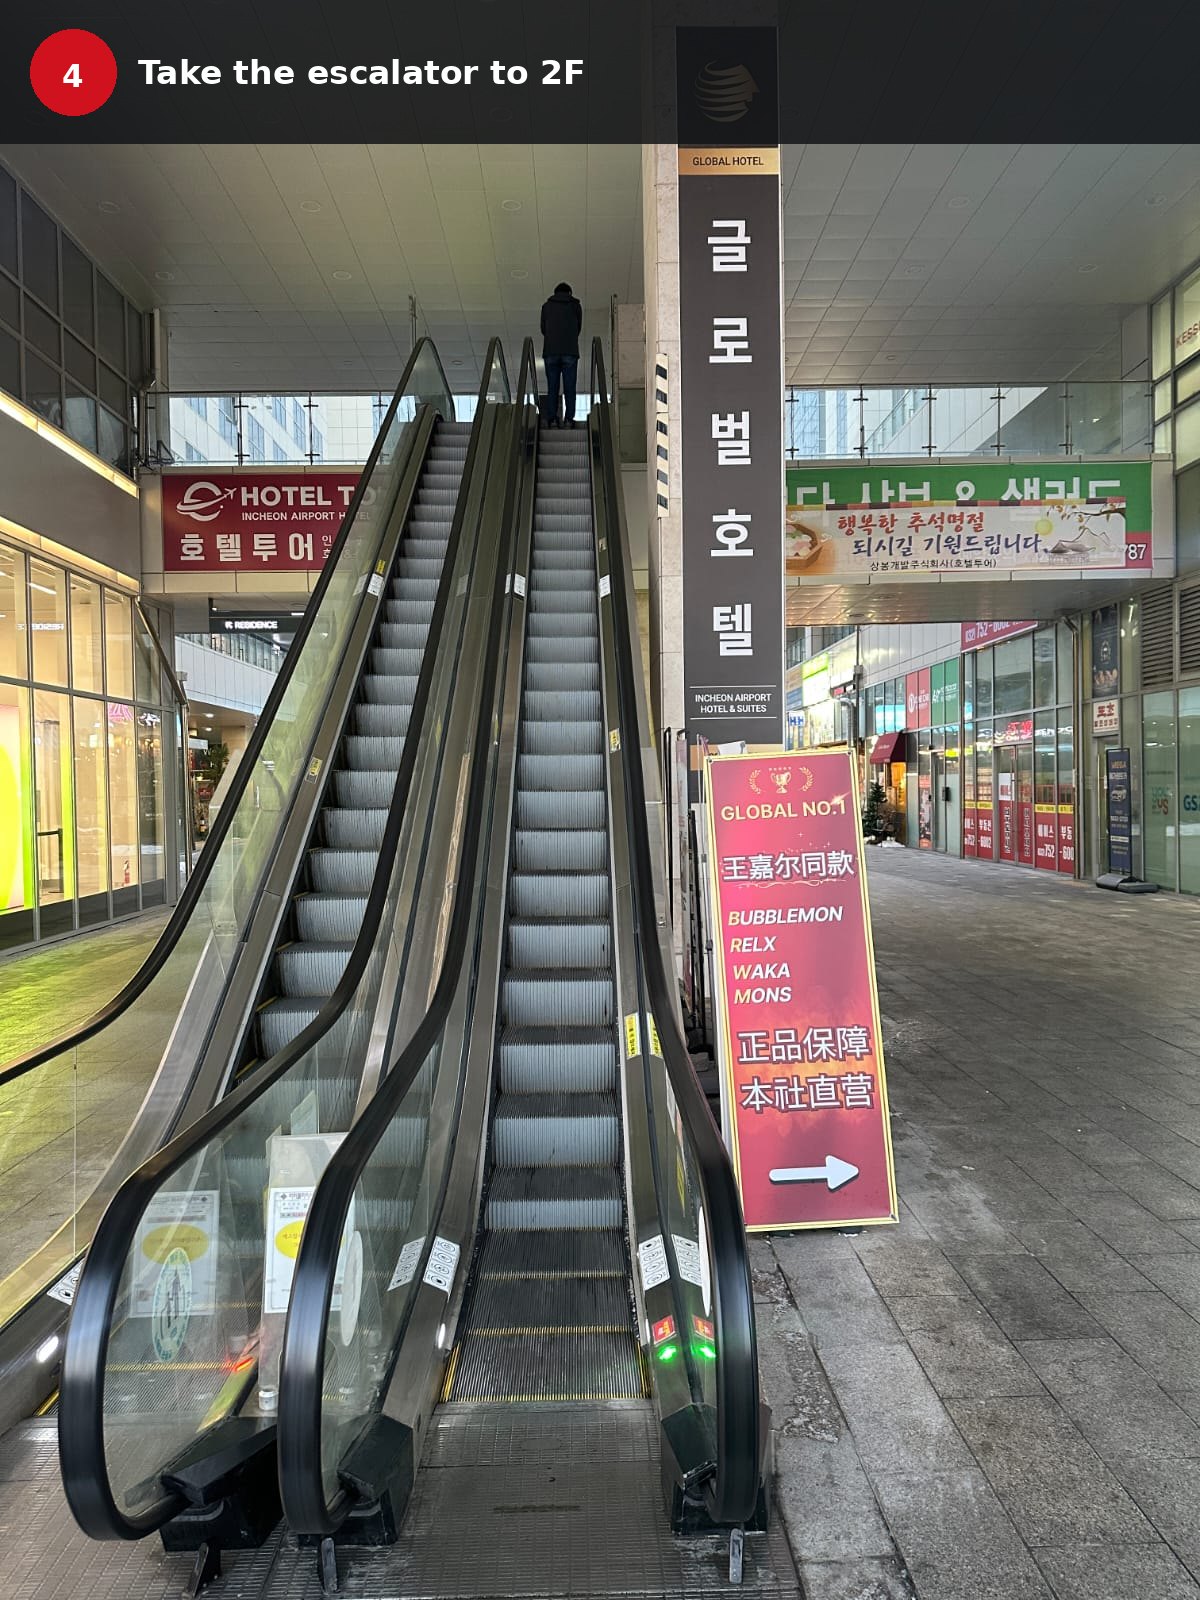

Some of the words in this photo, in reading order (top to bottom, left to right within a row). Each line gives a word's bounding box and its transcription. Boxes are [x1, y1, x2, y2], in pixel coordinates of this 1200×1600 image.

[692, 156, 731, 167] GLOBAL
[733, 156, 764, 166] HOTEL
[241, 486, 332, 506] HOTEL
[241, 512, 288, 521] INCHEON
[291, 512, 334, 521] AIRPORT
[838, 513, 898, 537] 행복한
[907, 511, 986, 535] 추석명절
[853, 534, 912, 557] 되시길
[234, 621, 278, 629] RESIDENCE
[694, 694, 734, 703] INCHEON
[735, 693, 771, 702] AIRPORT
[700, 705, 729, 713] HOTEL
[730, 704, 735, 713] &
[735, 704, 767, 713] SUITES
[721, 802, 798, 821] GLOBAL
[803, 799, 846, 817] NO.1
[722, 850, 855, 881] 王嘉尔同款
[727, 906, 843, 927] BUBBLEMON
[730, 936, 777, 953] RELX
[733, 962, 791, 980] WAKA
[734, 986, 792, 1004] MONS
[737, 1026, 871, 1063] 正品保障
[740, 1073, 874, 1112] 本社直营
